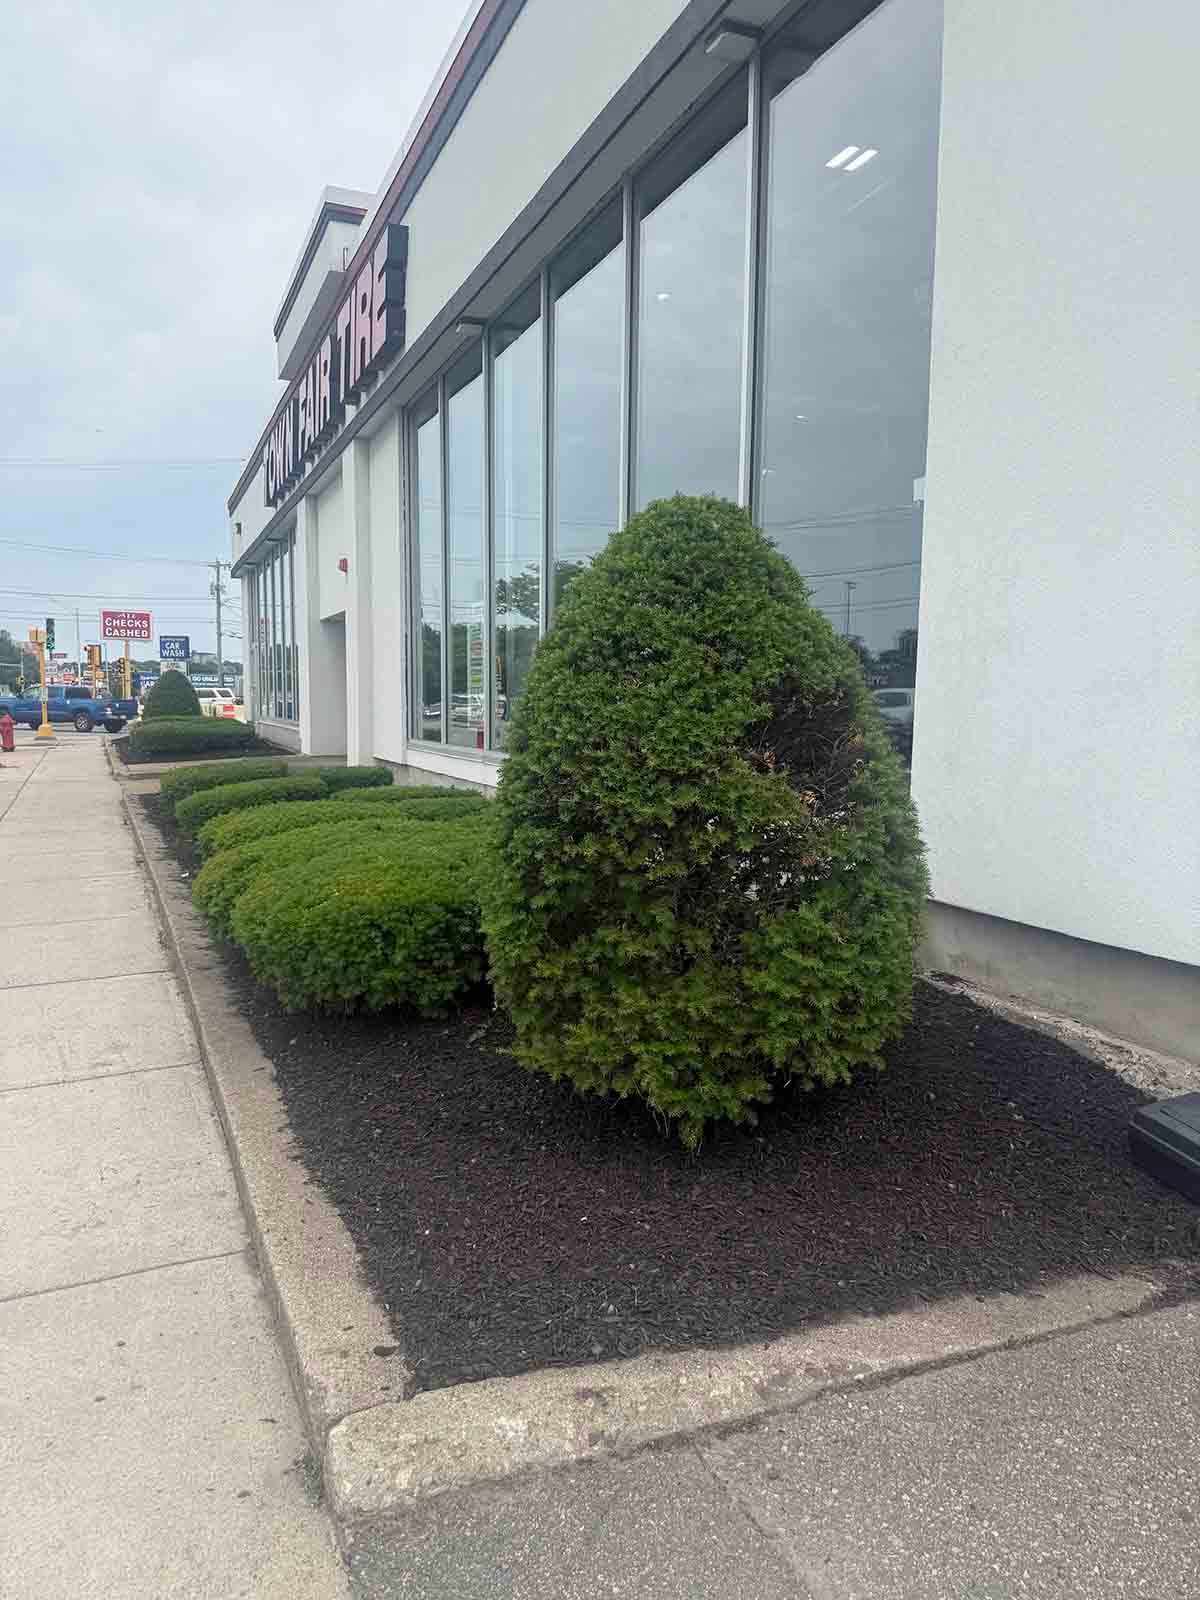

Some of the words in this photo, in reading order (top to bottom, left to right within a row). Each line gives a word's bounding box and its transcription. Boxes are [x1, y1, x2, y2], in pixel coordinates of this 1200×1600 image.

[299, 335, 338, 466] FAIR
[337, 224, 404, 406] TIRE
[105, 617, 149, 628] CHECKS
[105, 628, 149, 638] CASHED
[164, 642, 180, 650] CAR
